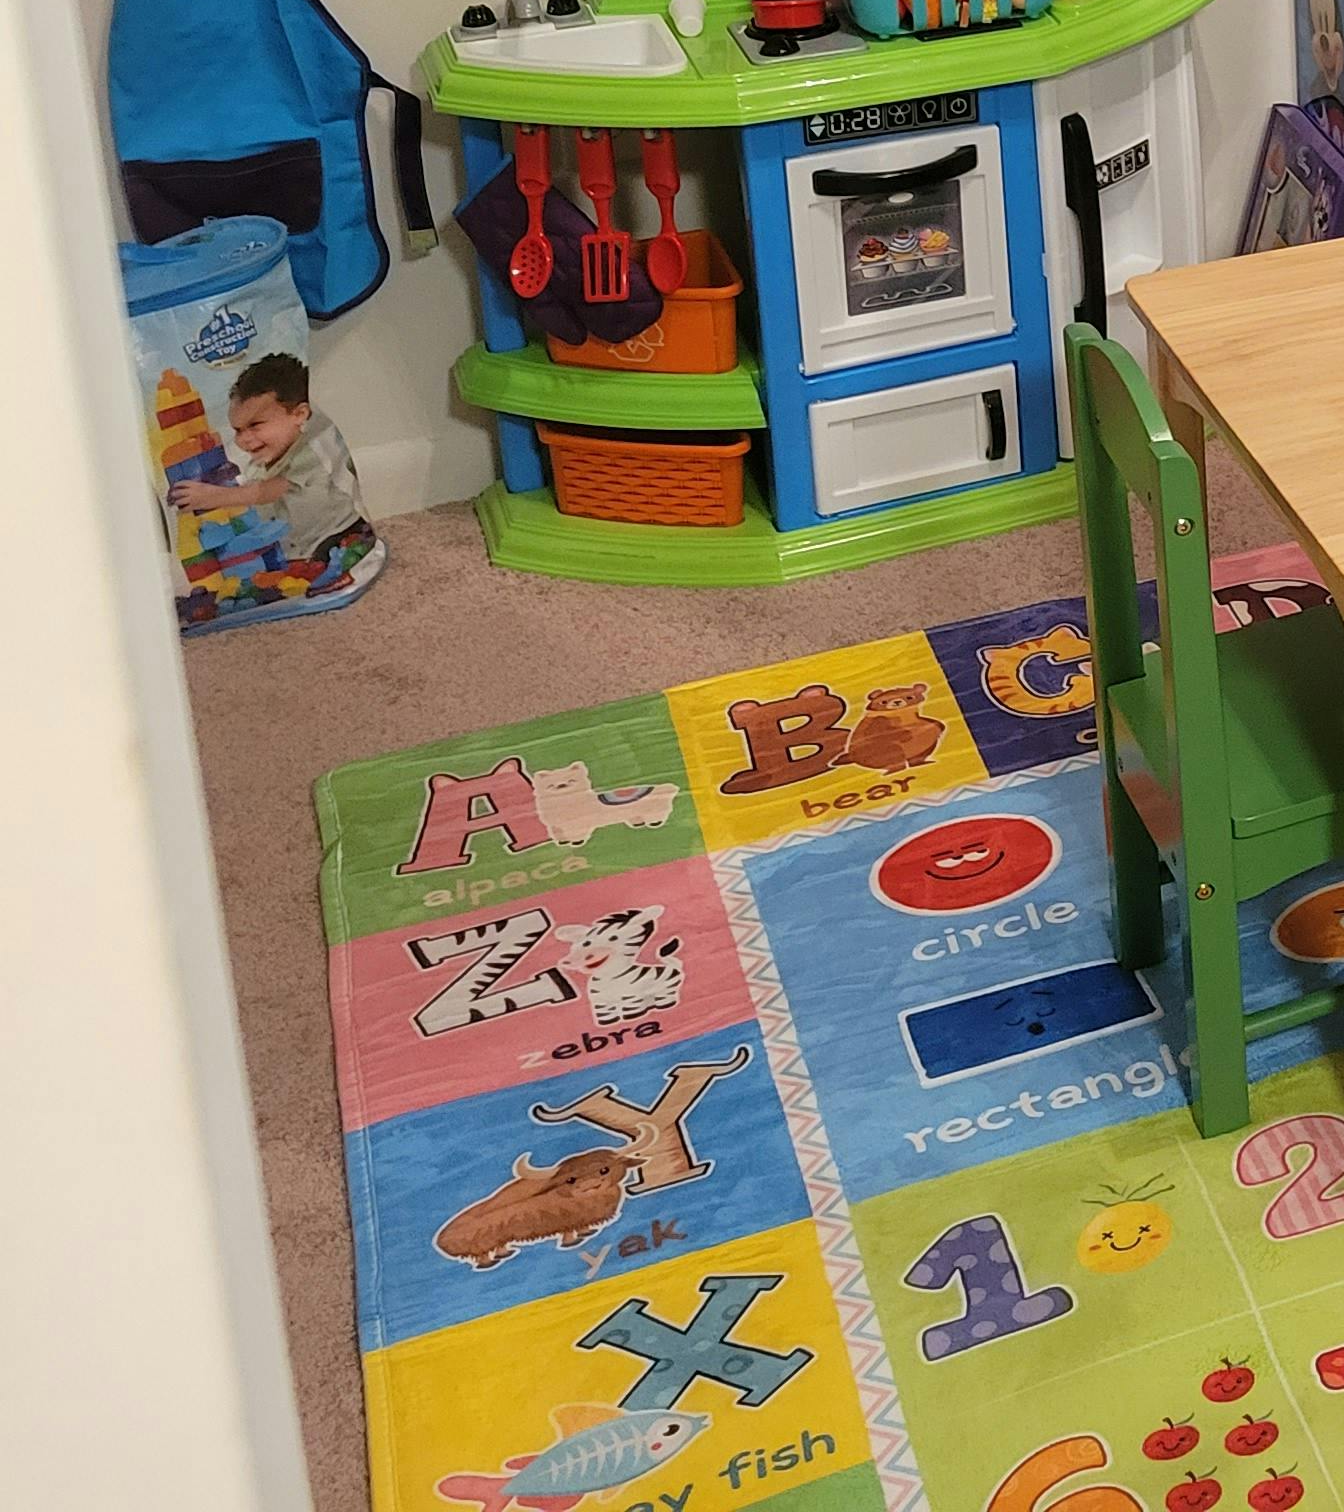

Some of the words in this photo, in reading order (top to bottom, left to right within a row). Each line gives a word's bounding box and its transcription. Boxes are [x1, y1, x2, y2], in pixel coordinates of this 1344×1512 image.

[830, 108, 881, 134] 0:28
[185, 316, 254, 354] Preschool
[191, 328, 255, 360] Construction
[216, 344, 236, 357] Toy
[976, 623, 1094, 718] C
[720, 685, 851, 797] B
[392, 755, 555, 877] A
[801, 775, 916, 820] bear
[422, 851, 591, 910] alpaca
[910, 897, 1080, 966] circle
[412, 908, 578, 1039] Z
[518, 1018, 664, 1070] zebra
[531, 1045, 751, 1197] Y
[574, 1213, 688, 1280] yak
[903, 1211, 1076, 1363] 1
[576, 1273, 816, 1408] X
[718, 1427, 837, 1493] fish
